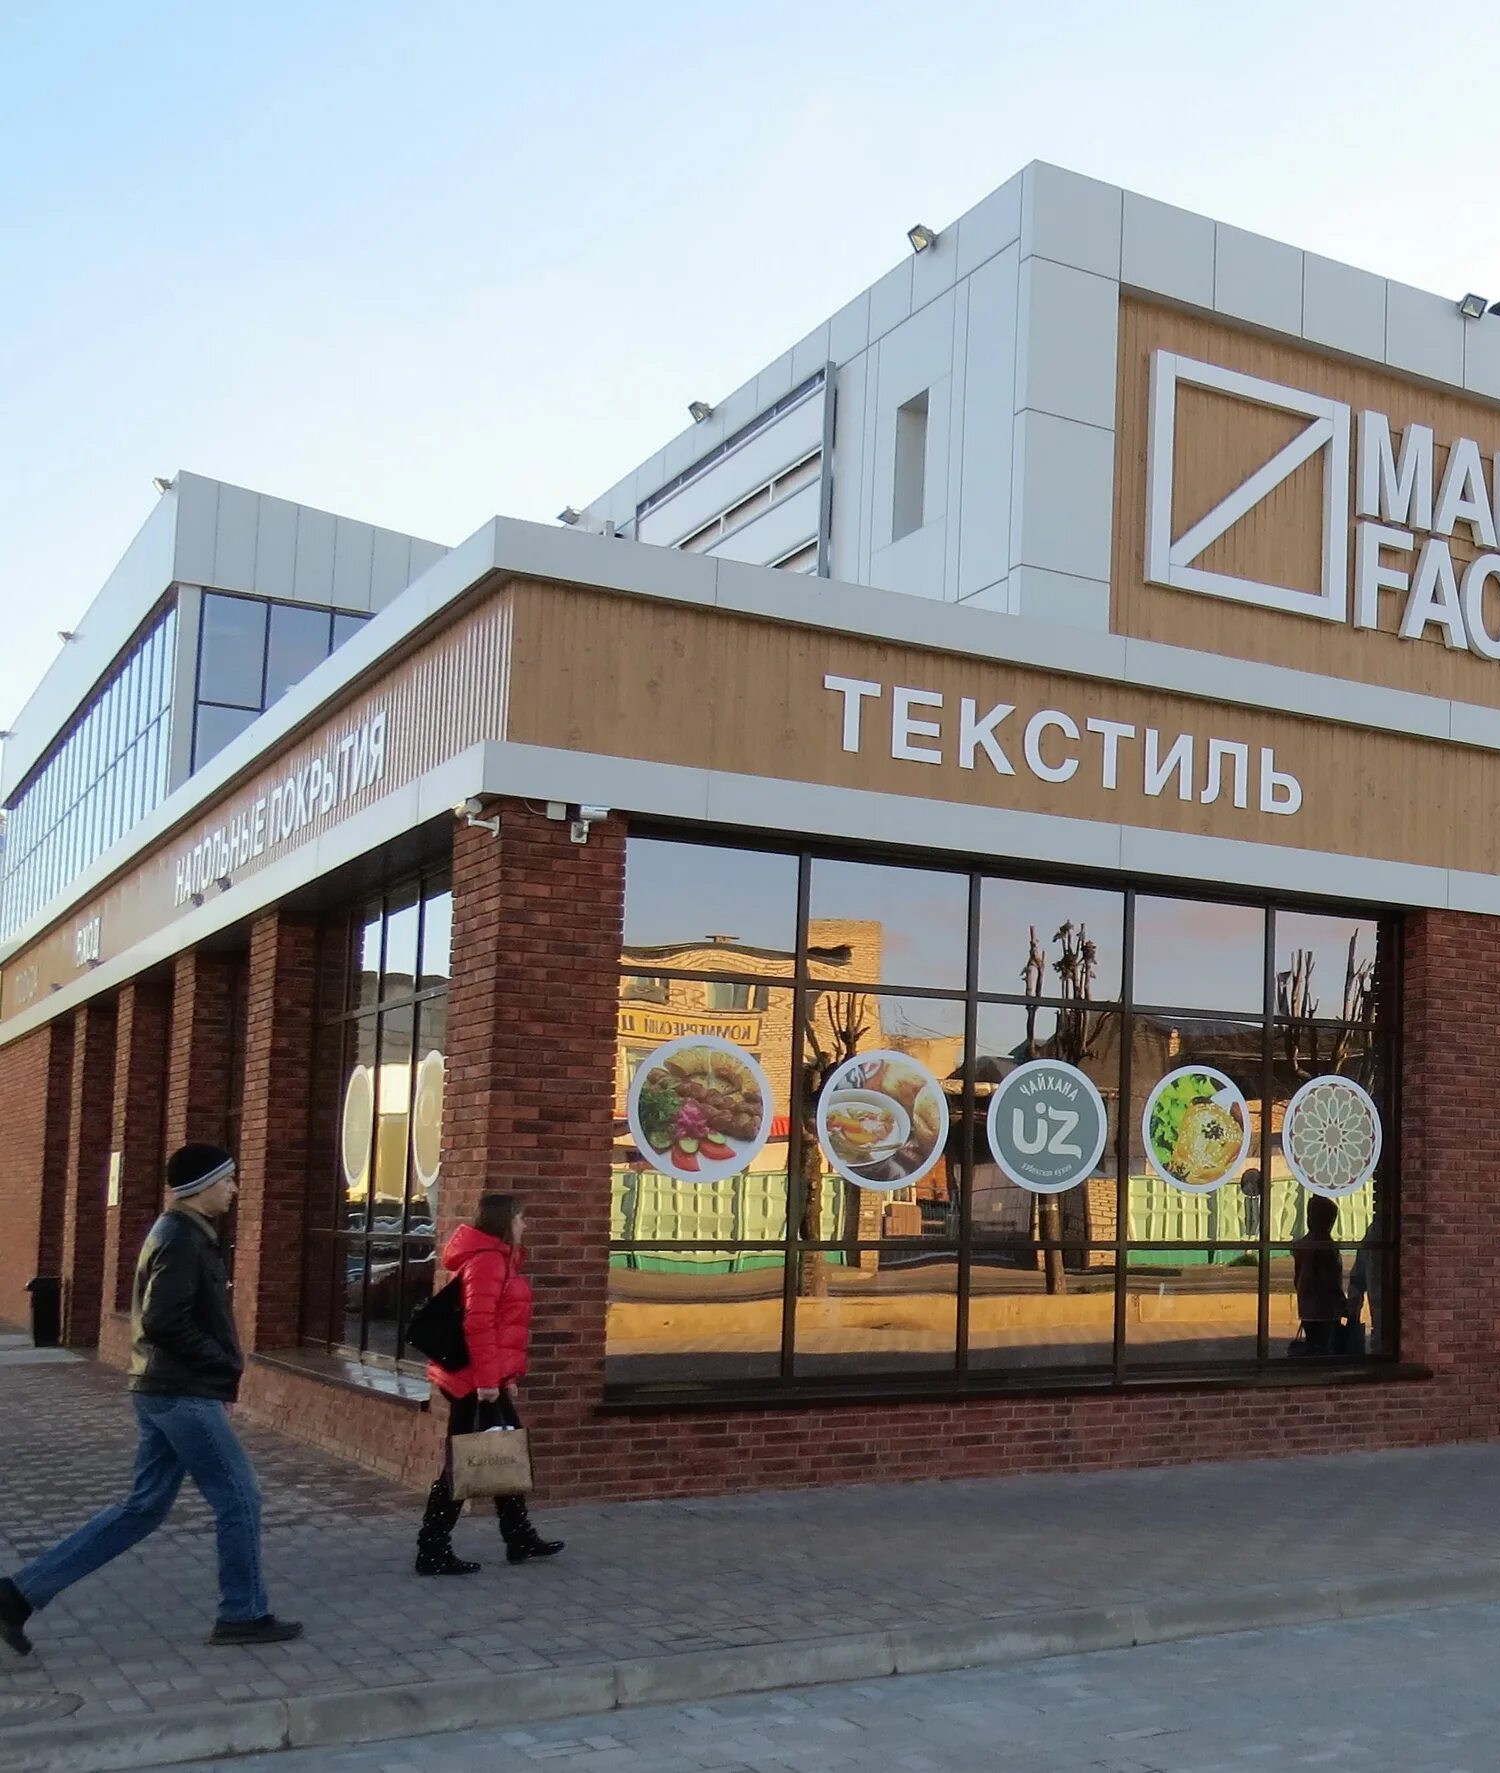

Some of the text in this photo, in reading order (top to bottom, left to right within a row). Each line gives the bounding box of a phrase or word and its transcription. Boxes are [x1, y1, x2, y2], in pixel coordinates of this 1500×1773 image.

[174, 711, 388, 908] НАПОЛЬНЫЕ ПОКРЫТИЯ
[823, 674, 1304, 816] ТЕКСТИЛЬ
[1019, 1072, 1080, 1102] ЧАЙХАНА
